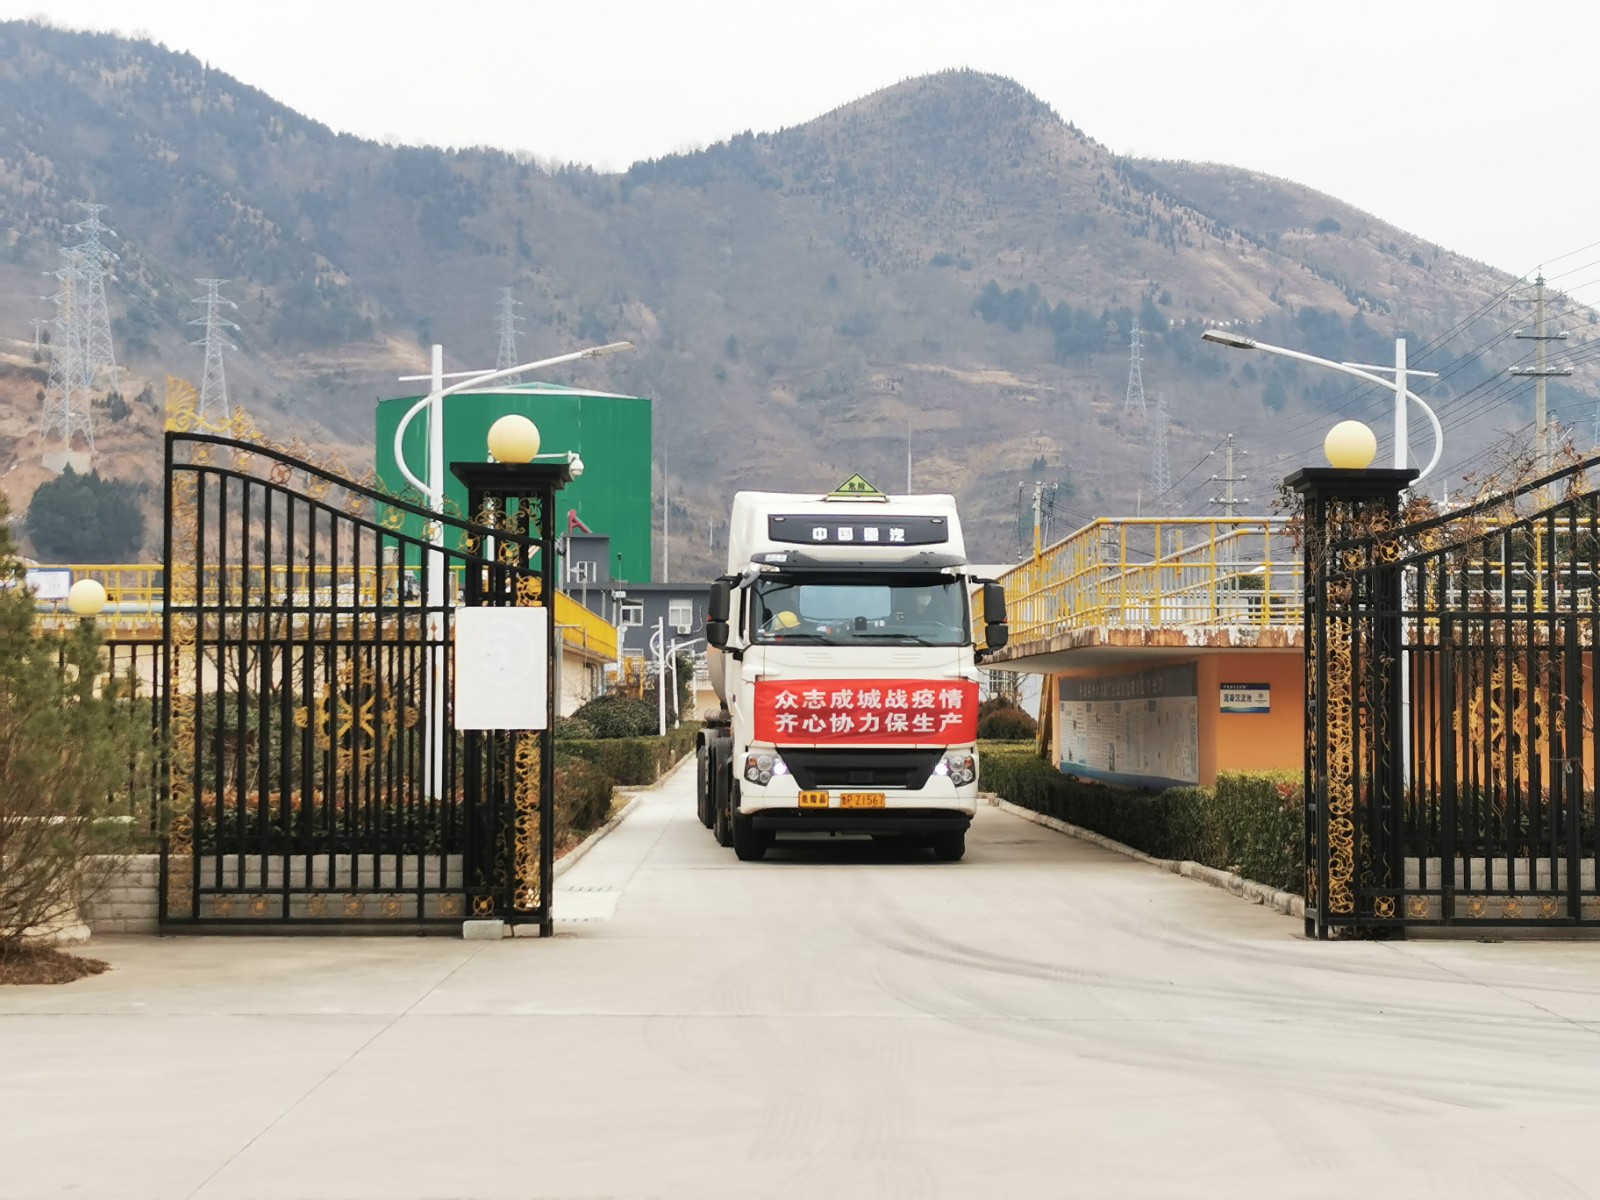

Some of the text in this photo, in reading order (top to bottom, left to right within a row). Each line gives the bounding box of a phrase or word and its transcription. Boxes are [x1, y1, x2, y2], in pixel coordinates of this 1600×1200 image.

[812, 526, 905, 542] 中国重汽
[774, 688, 963, 710] 众志成城战疫情
[774, 712, 963, 733] 齐心协力保生产
